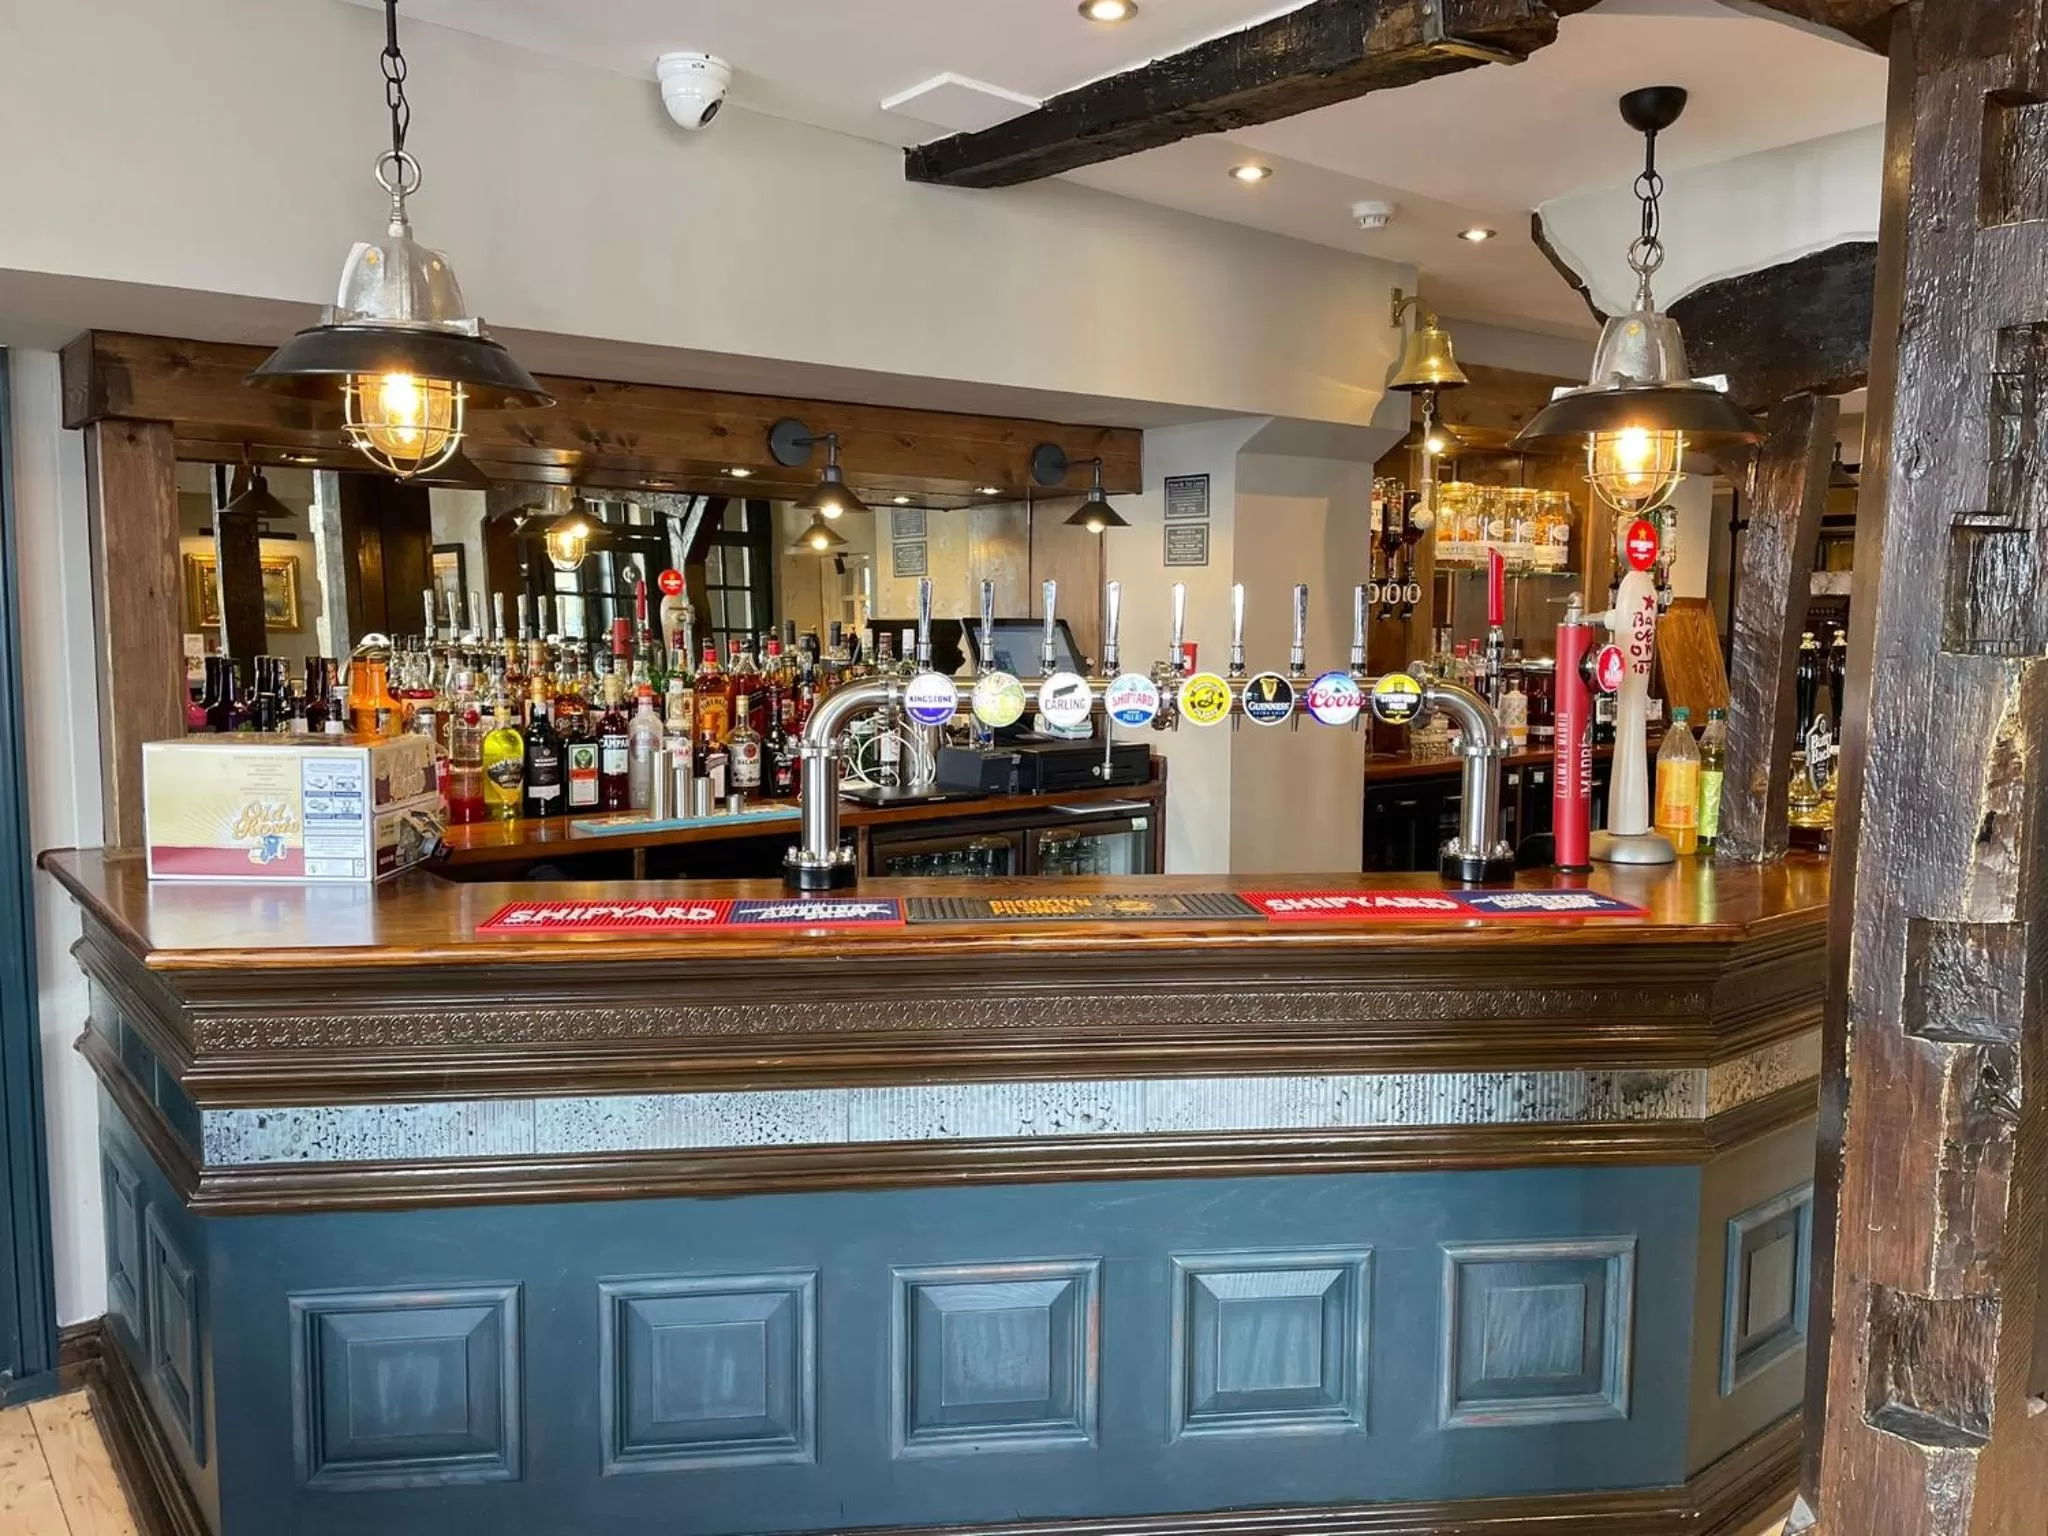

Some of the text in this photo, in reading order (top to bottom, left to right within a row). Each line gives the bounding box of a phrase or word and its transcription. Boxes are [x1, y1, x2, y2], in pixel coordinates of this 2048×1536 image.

[1045, 698, 1086, 711] CARLING
[1248, 701, 1291, 711] GUINNESS
[1308, 686, 1366, 710] Coors
[1265, 896, 1459, 912] SHIPYARD
[503, 906, 717, 925] SHIPYARD
